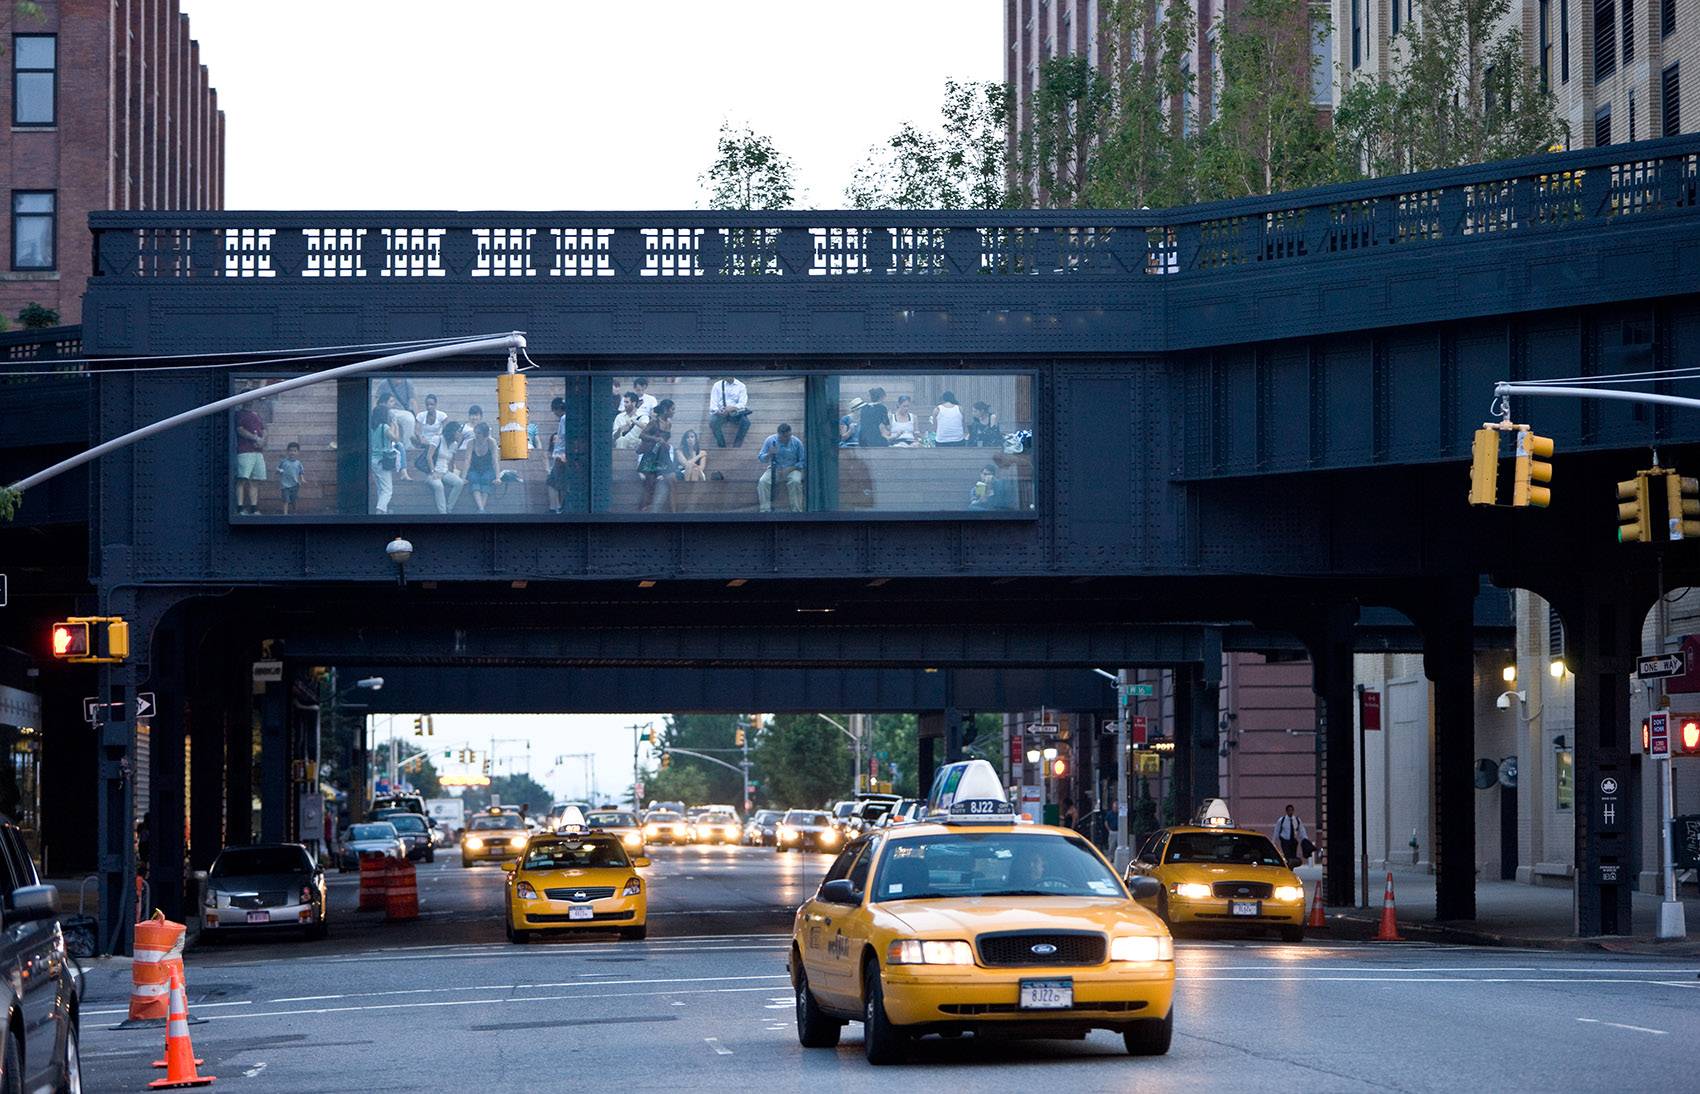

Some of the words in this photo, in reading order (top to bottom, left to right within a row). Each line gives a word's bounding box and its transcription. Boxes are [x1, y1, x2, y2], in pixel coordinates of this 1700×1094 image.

[1644, 662, 1658, 673] ONE
[1663, 660, 1678, 670] WAY
[970, 801, 994, 813] 8J22
